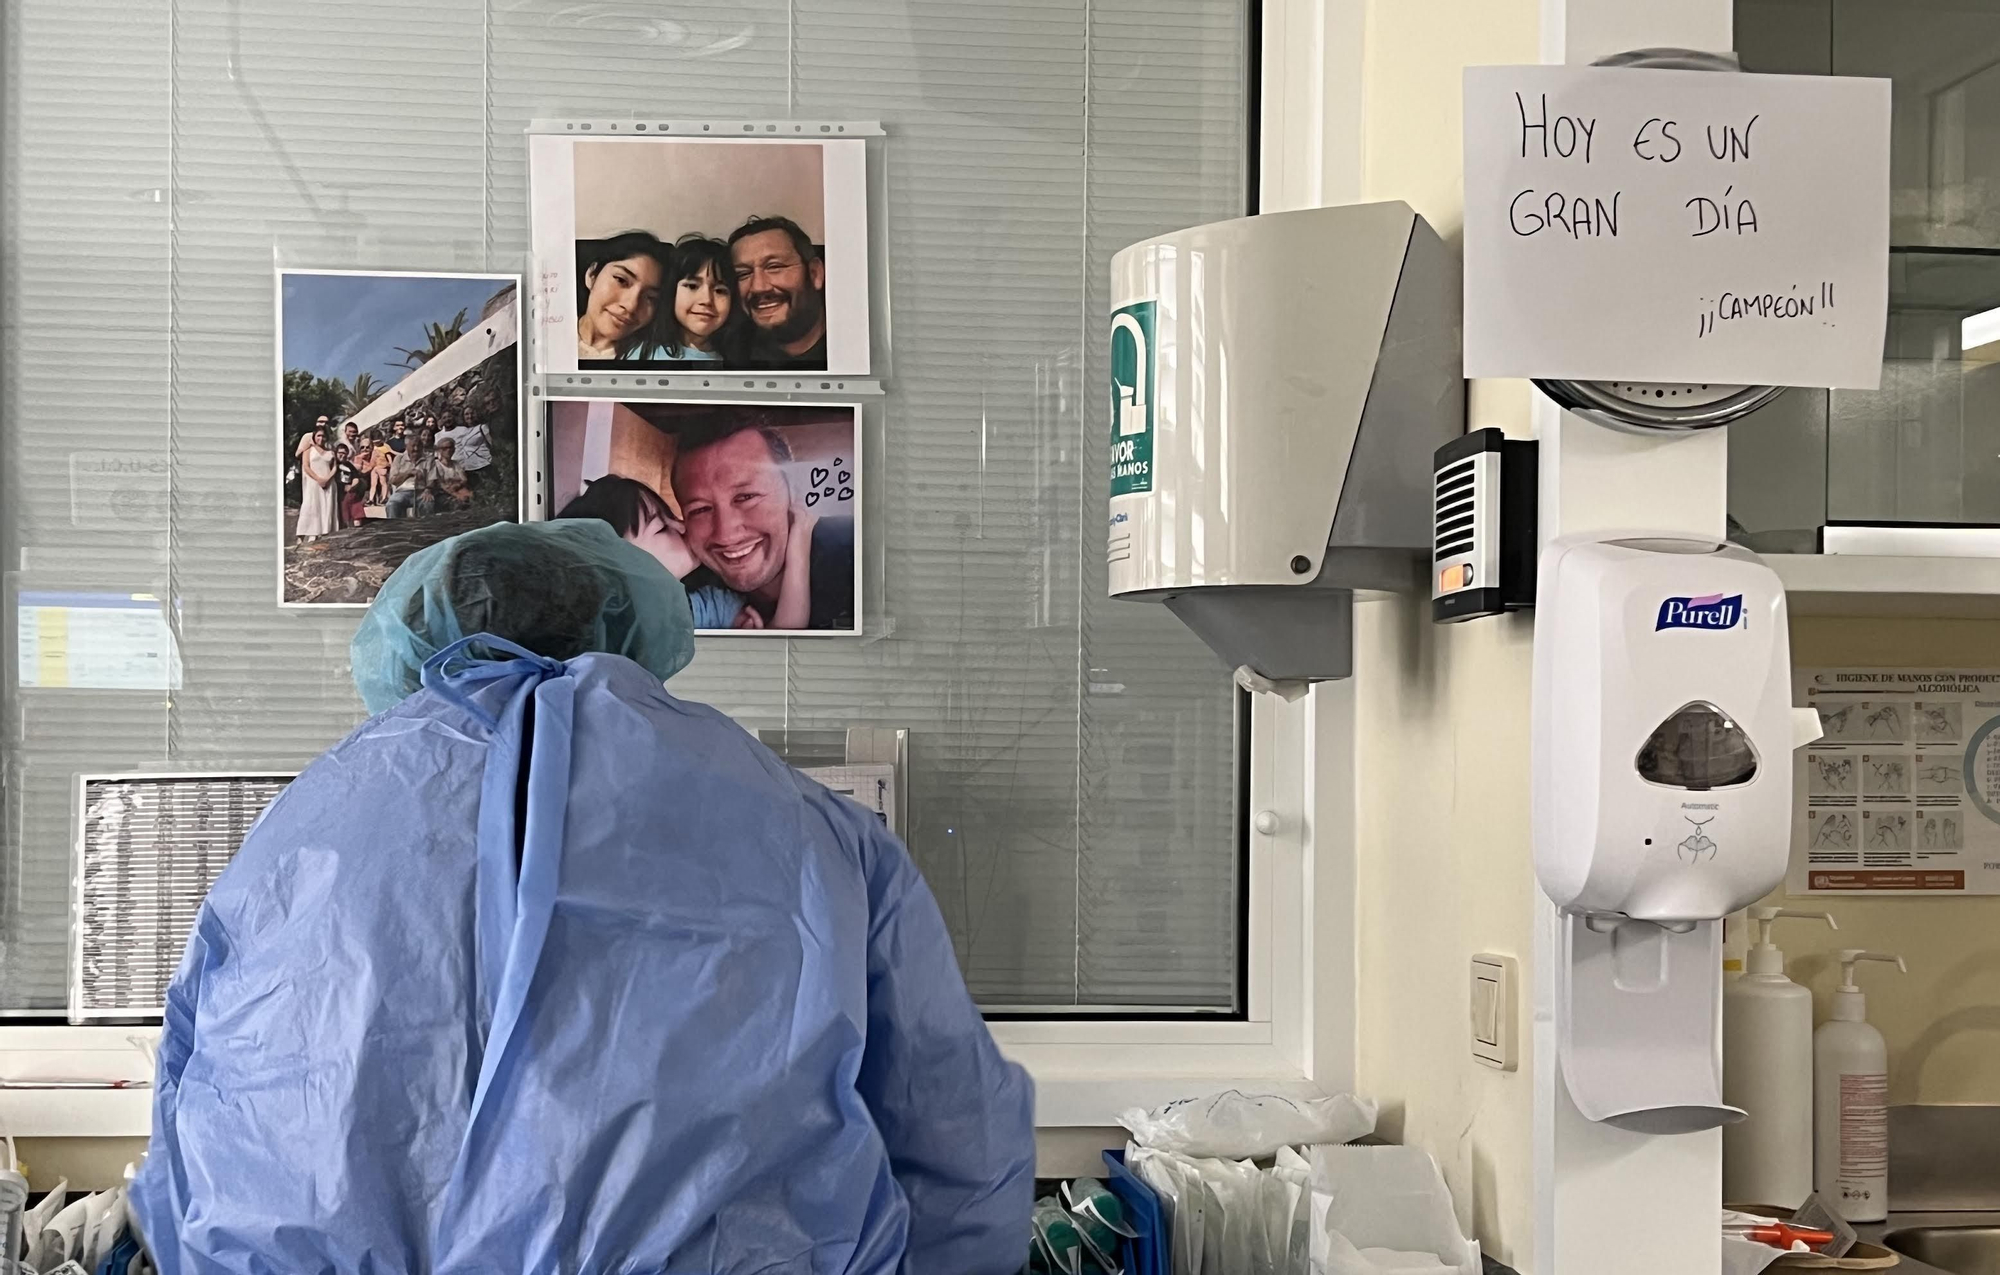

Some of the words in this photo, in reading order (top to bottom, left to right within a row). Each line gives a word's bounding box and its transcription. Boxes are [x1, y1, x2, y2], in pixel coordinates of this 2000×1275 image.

[1515, 91, 1596, 164] HOY
[1633, 118, 1681, 162] ES
[1706, 114, 1760, 161] UN
[1509, 189, 1621, 239] GRAN
[1685, 185, 1758, 237] DÍA
[1698, 281, 1837, 338] ¡¡CAMPEÓN!!
[1117, 461, 1148, 477] MANOS
[1665, 601, 1733, 626] Purell
[1836, 673, 1878, 683] HIGIENE
[1881, 674, 1894, 683] DE
[1898, 674, 1932, 683] MANOS
[1934, 674, 1956, 683] CON
